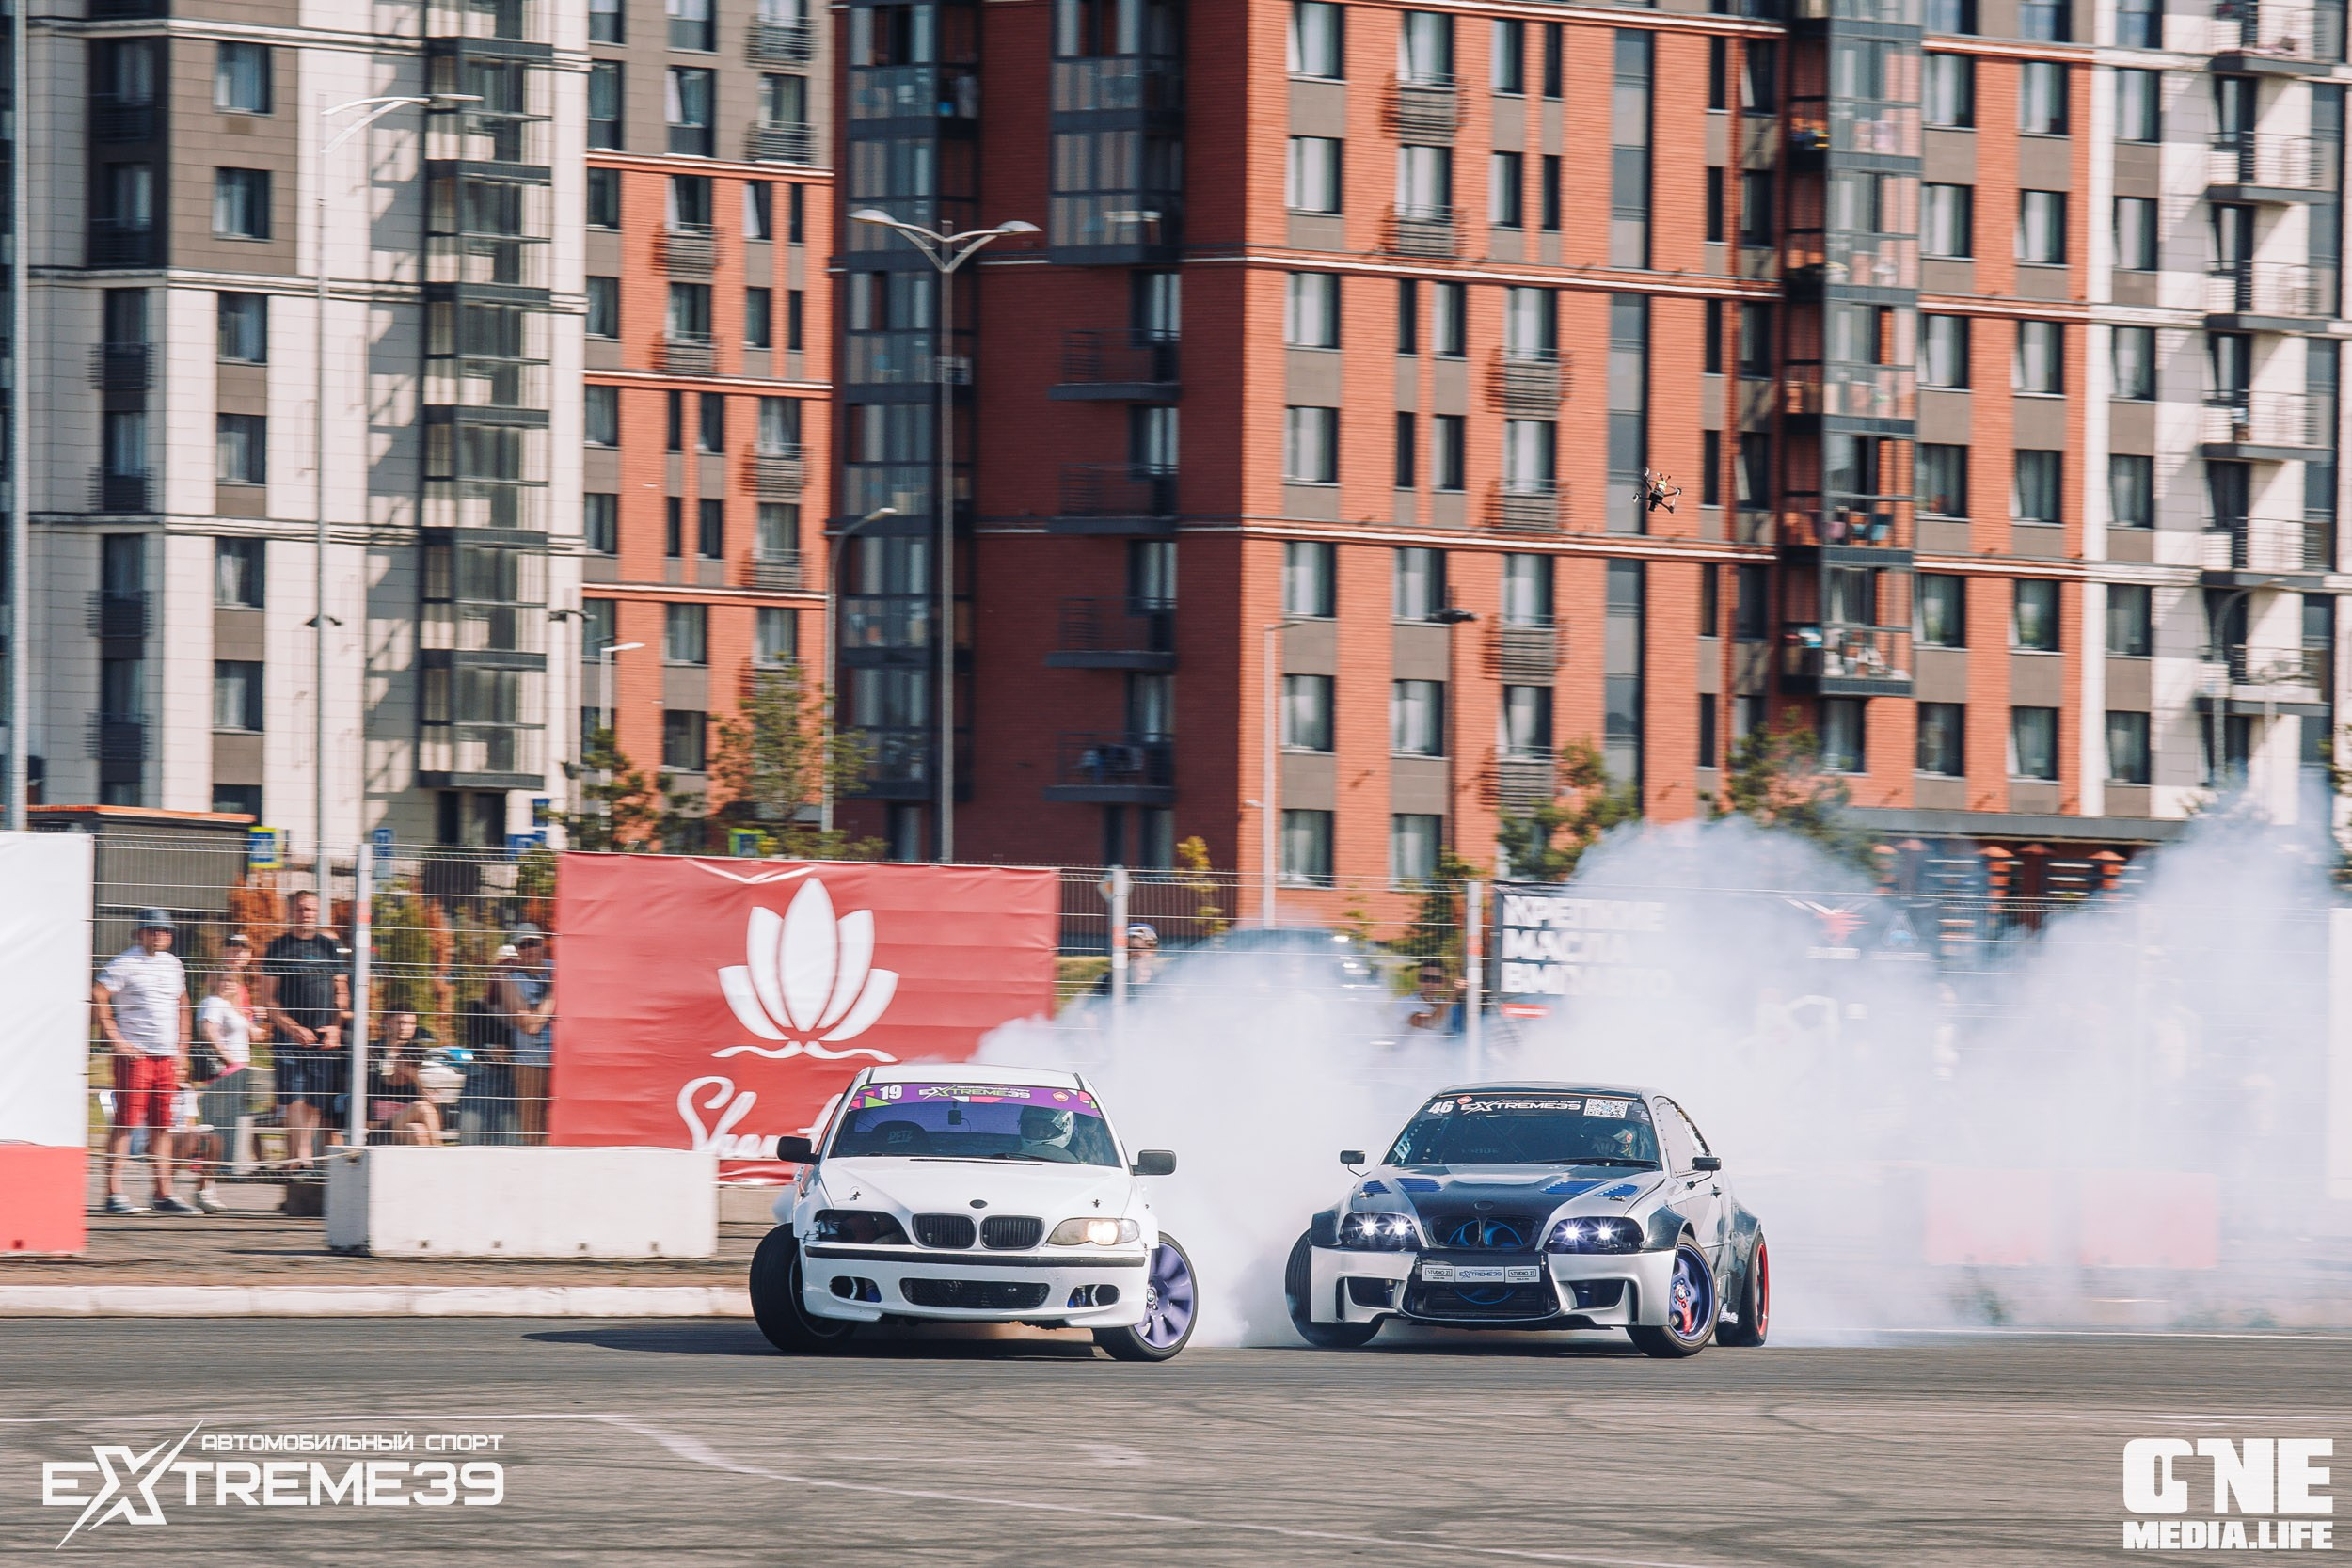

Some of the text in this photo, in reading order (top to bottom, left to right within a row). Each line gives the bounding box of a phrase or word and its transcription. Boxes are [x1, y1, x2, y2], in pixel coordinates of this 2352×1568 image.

[880, 1085, 1031, 1100] 19 EXTREME39
[1428, 1099, 1581, 1115] 46 EXTREME39
